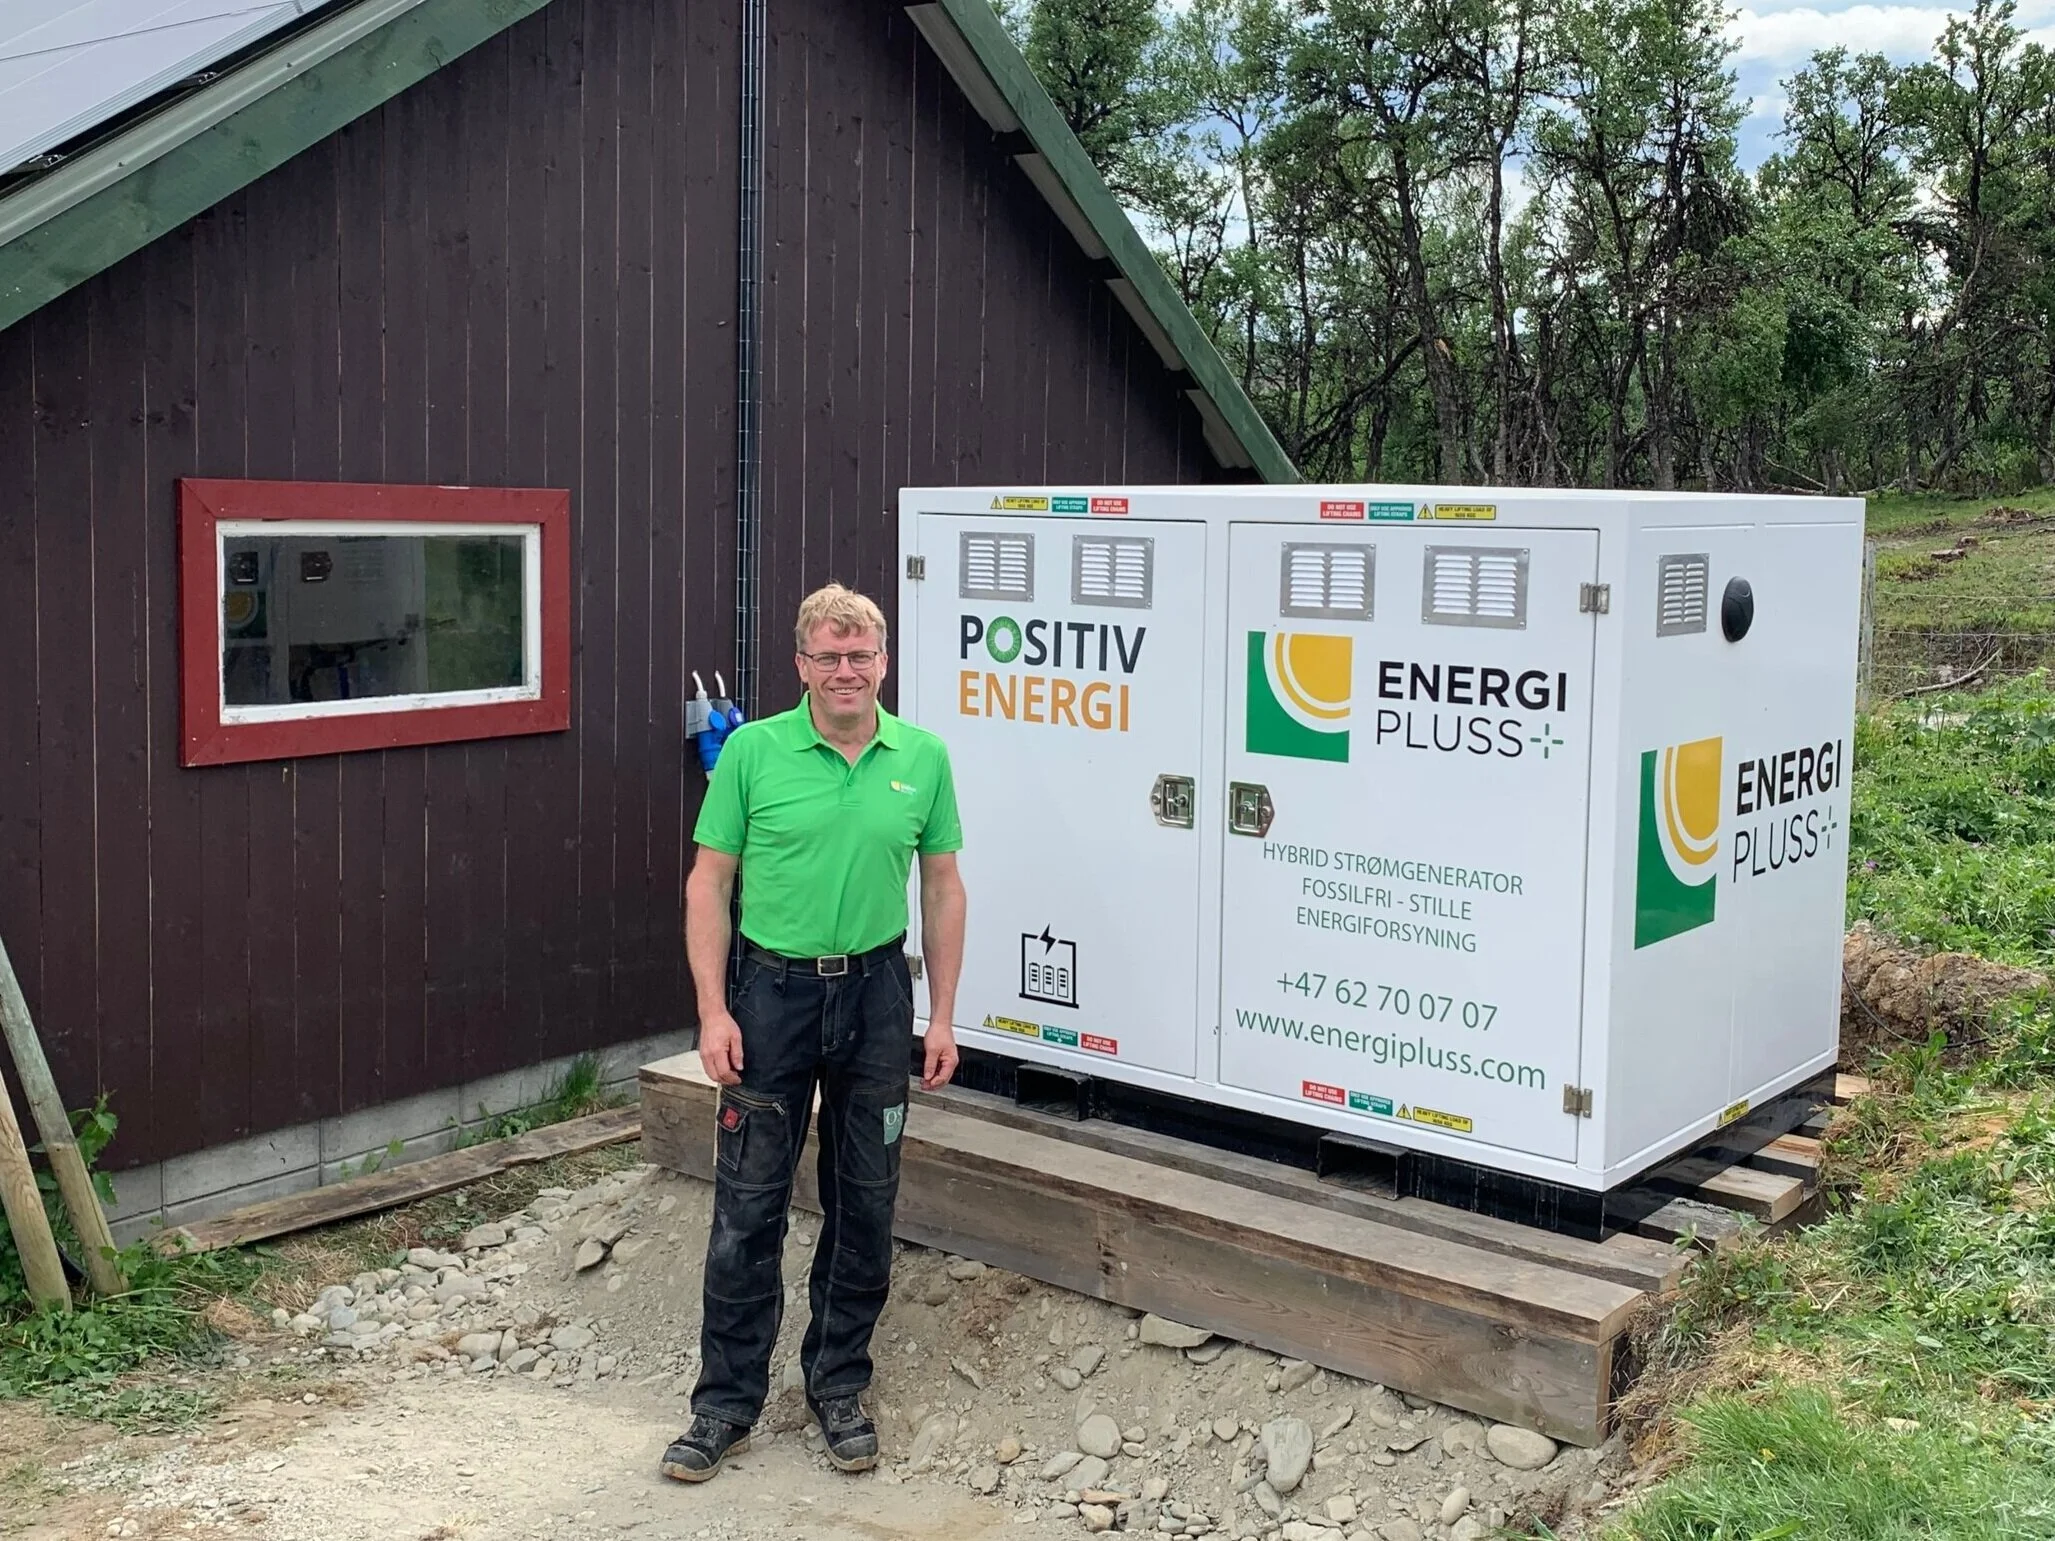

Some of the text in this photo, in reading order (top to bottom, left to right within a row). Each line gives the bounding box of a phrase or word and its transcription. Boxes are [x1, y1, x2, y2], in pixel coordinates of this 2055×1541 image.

[961, 615, 1146, 674] POSITIV
[960, 671, 1129, 732] ENERGI
[1379, 661, 1566, 712] ENERGI
[1737, 739, 1841, 816] ENERGI
[1263, 842, 1523, 895] HYBRID STRØMGENERATOR
[1303, 877, 1392, 908] FOSSILFRI
[1409, 894, 1472, 920] STILLE
[1297, 906, 1477, 952] ENERGIFORSYNING
[1277, 972, 1498, 1031] +47 62 70 07 07
[1235, 1008, 1546, 1090] www.energipluss.com
